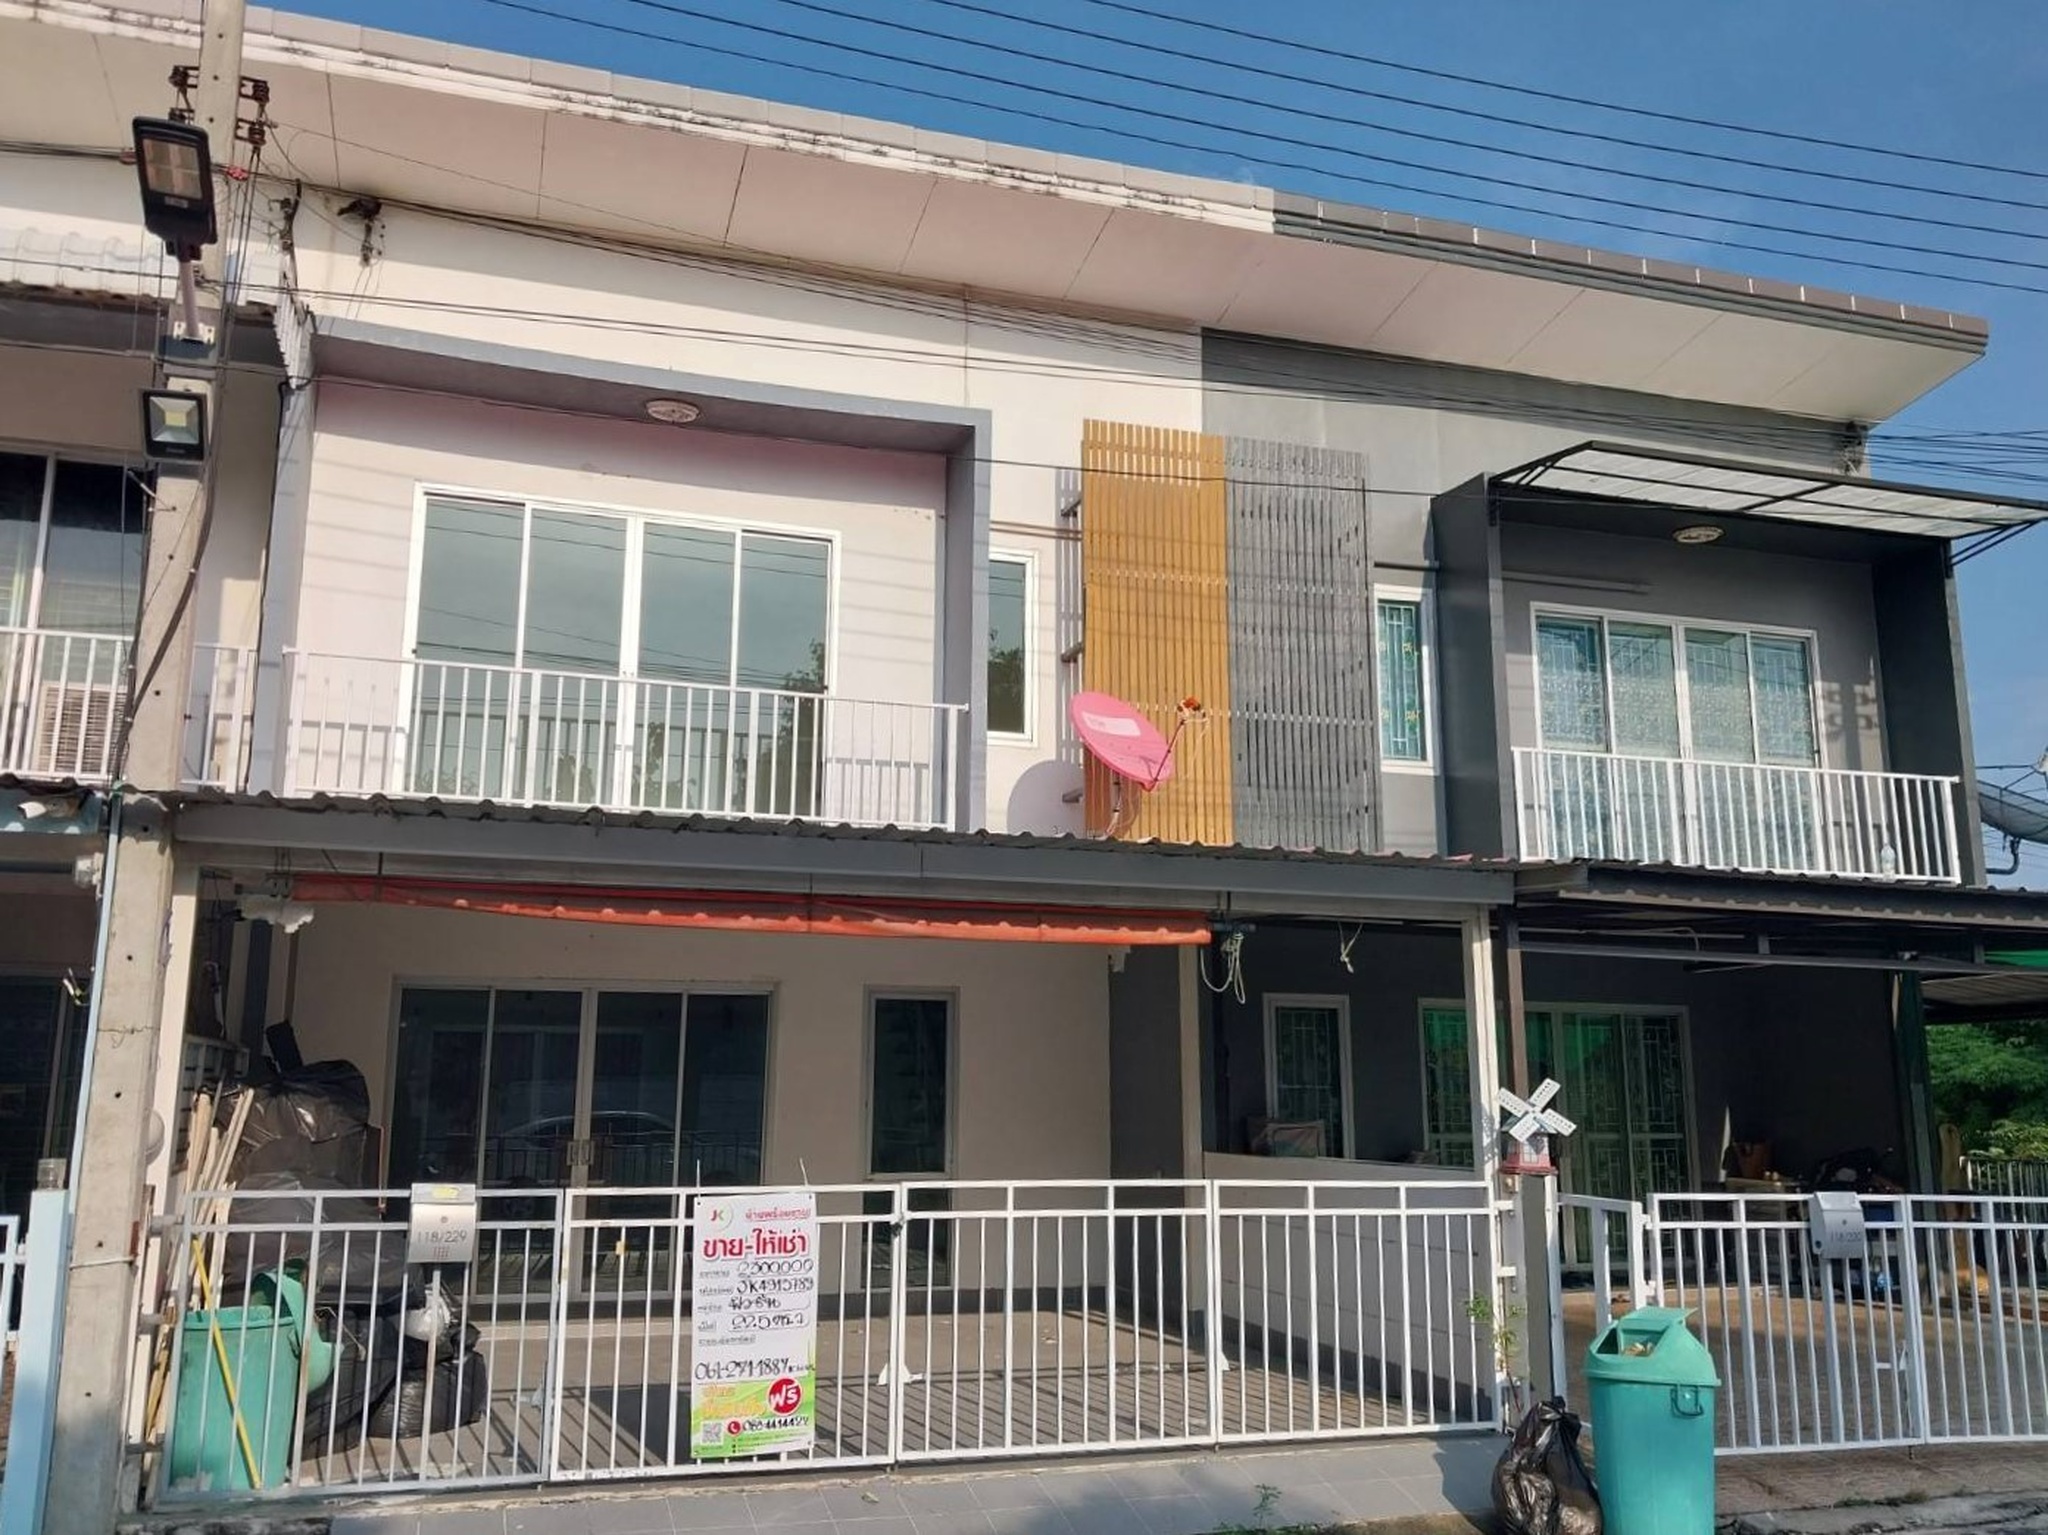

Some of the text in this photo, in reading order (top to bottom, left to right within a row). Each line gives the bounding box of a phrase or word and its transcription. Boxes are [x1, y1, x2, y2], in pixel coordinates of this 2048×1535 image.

[702, 1228, 807, 1258] ขาย-ให้เช่า
[769, 1380, 801, 1411] ฟรี
